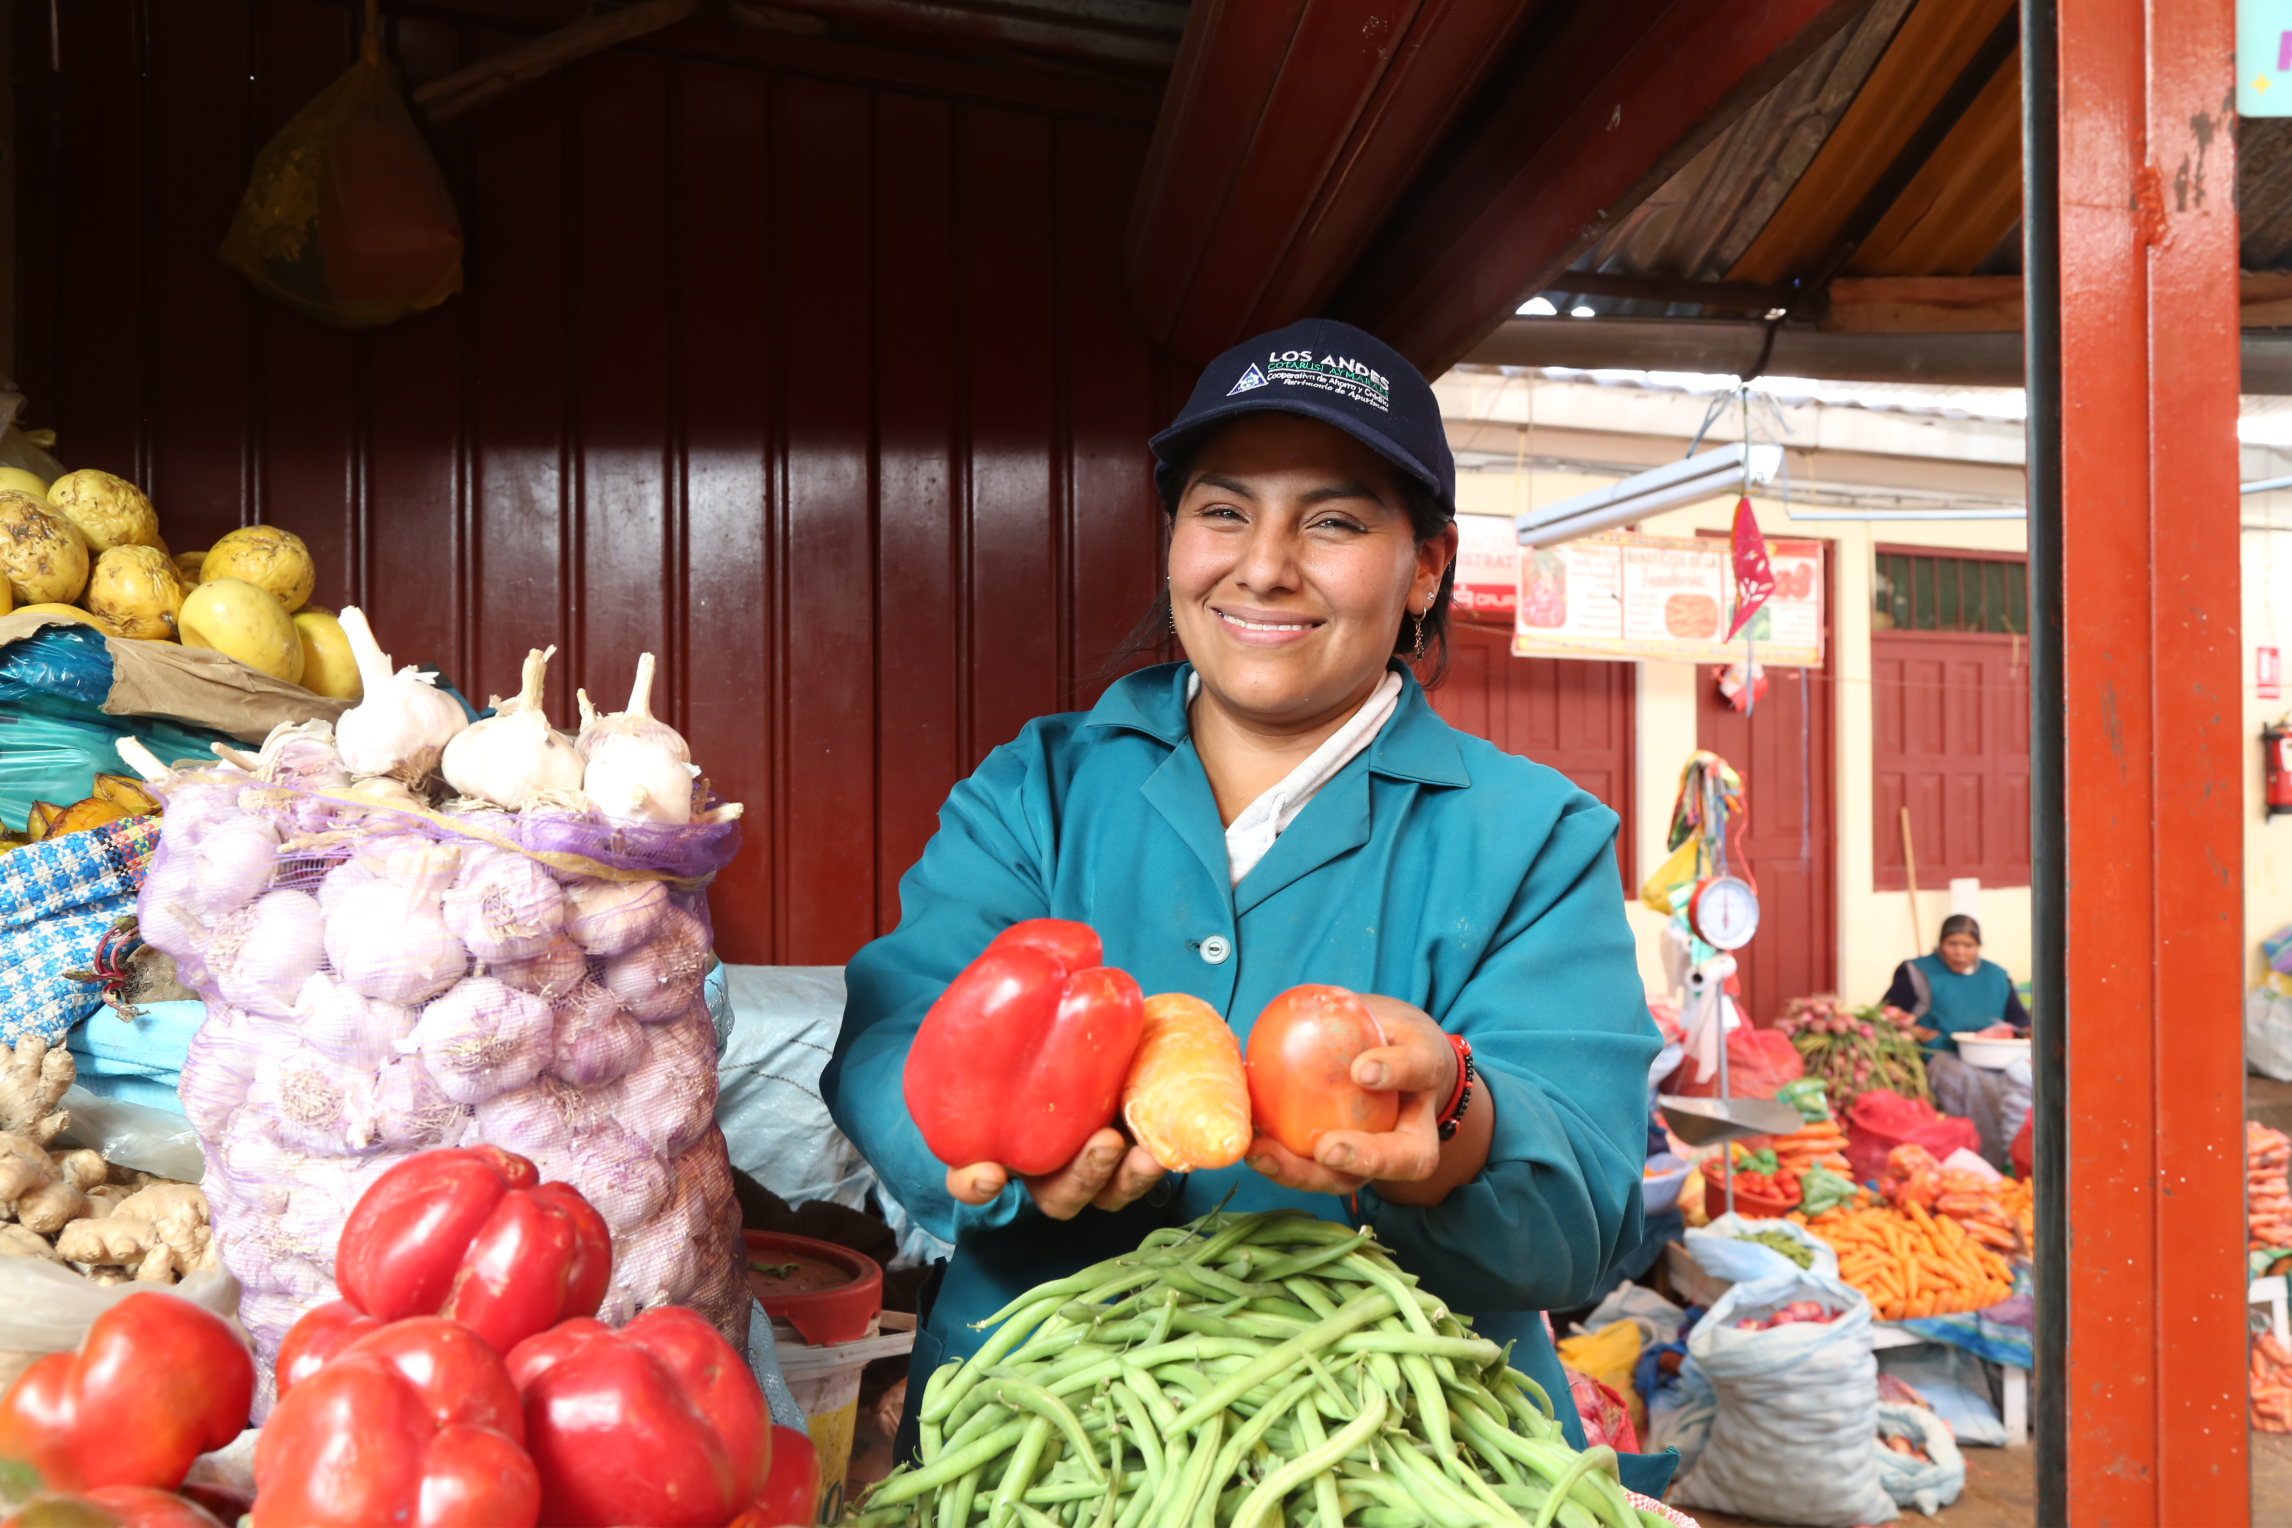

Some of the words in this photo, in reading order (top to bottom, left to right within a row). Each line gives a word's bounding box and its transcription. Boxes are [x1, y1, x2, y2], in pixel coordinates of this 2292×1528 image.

[1267, 361, 1325, 372] COTARUSI
[1269, 350, 1313, 363] LOS
[1320, 354, 1390, 391] ANDES
[1266, 372, 1316, 381] Cooperativa
[1316, 374, 1327, 383] de
[1329, 377, 1357, 391] Ahorro
[1335, 386, 1346, 395] de
